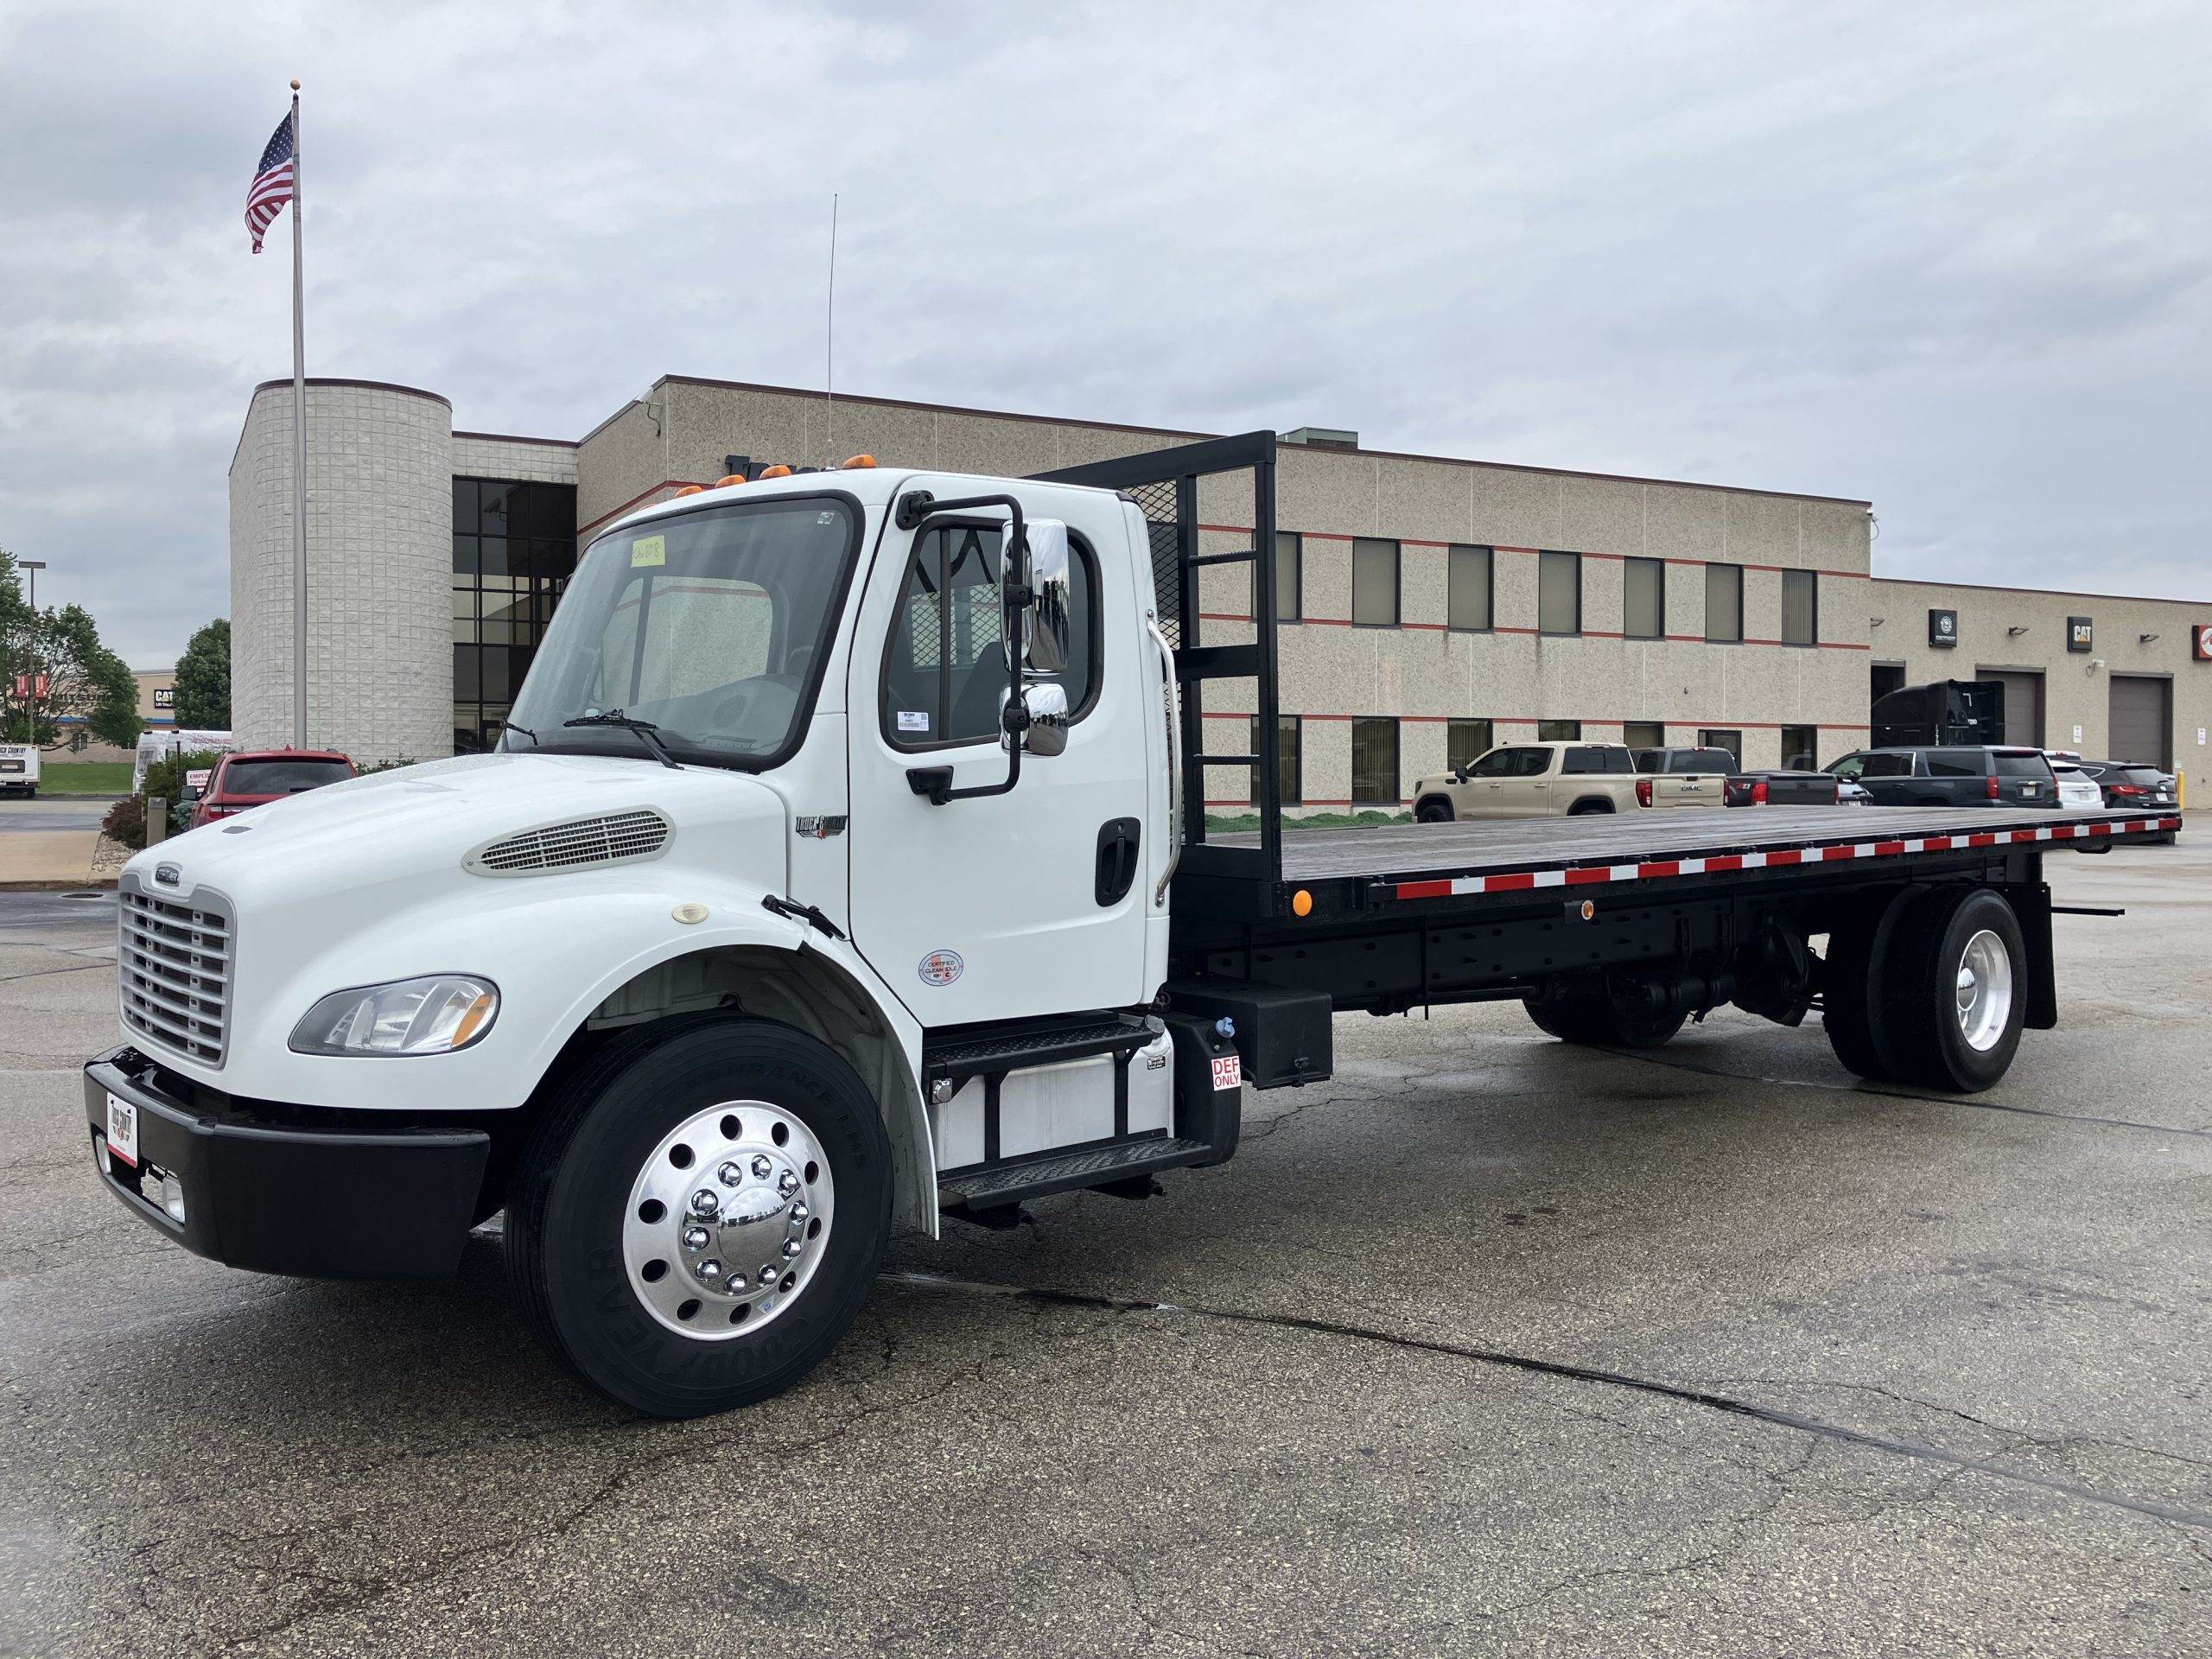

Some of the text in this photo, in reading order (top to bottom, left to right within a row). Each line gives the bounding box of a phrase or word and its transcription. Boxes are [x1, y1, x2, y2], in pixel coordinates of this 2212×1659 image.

[2074, 625, 2091, 642] CAT
[156, 690, 173, 702] CAT
[796, 816, 817, 831] TRUCK
[1213, 1057, 1238, 1075] DEF
[1215, 1073, 1239, 1087] ONLY
[587, 1245, 811, 1385] GOODYEAR
